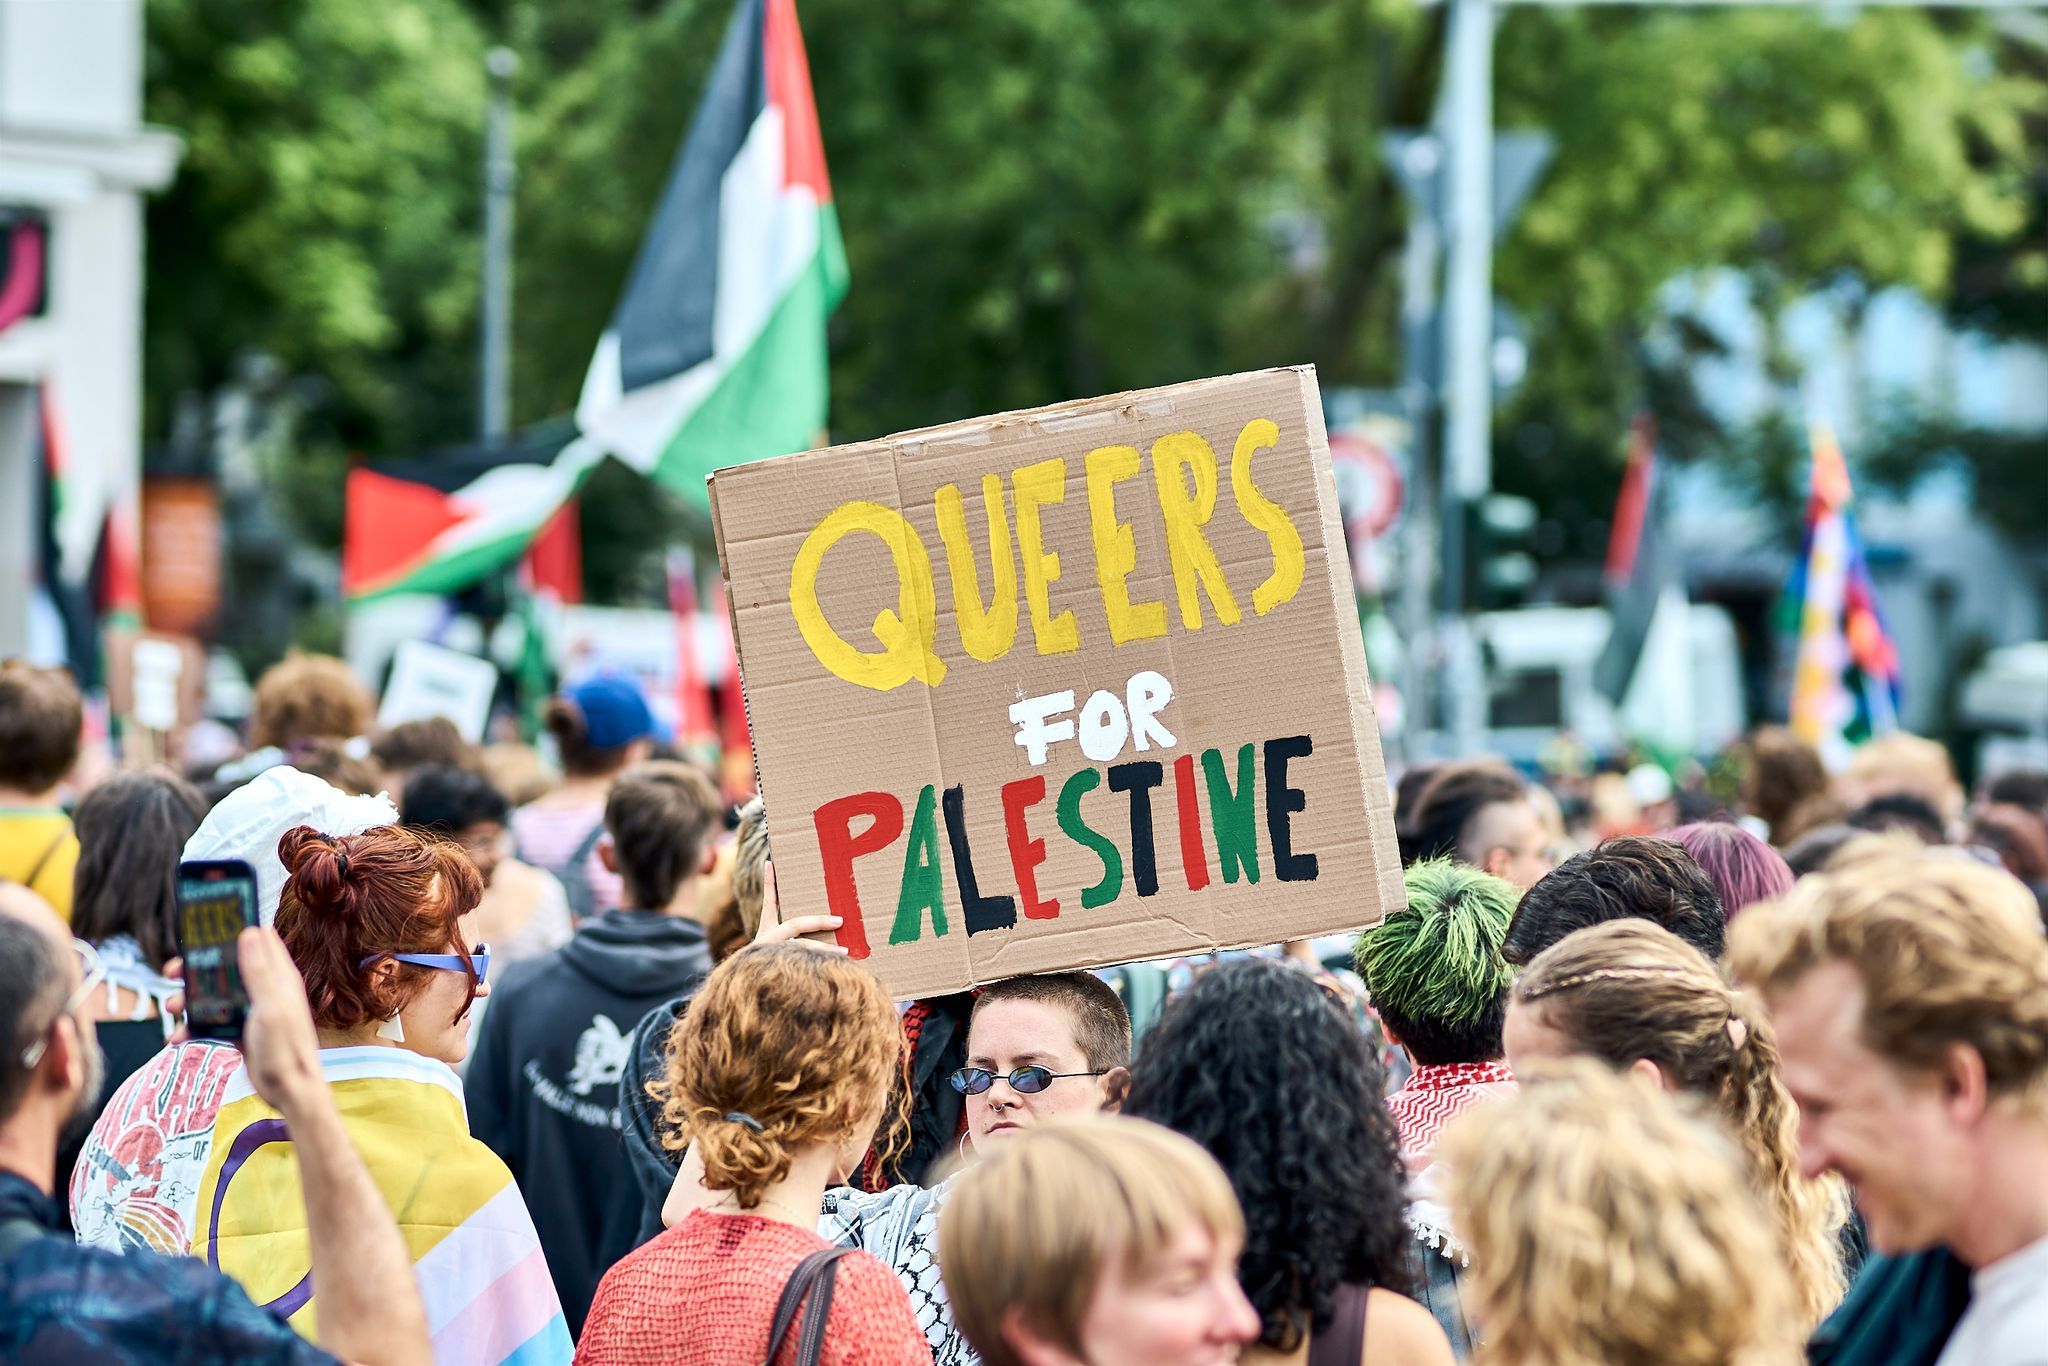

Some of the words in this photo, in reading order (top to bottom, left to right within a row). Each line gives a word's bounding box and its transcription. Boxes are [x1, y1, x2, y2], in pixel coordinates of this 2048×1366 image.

[789, 418, 1305, 691] QUEERS
[1008, 671, 1177, 766] FOR
[813, 734, 1319, 960] PALESTINE
